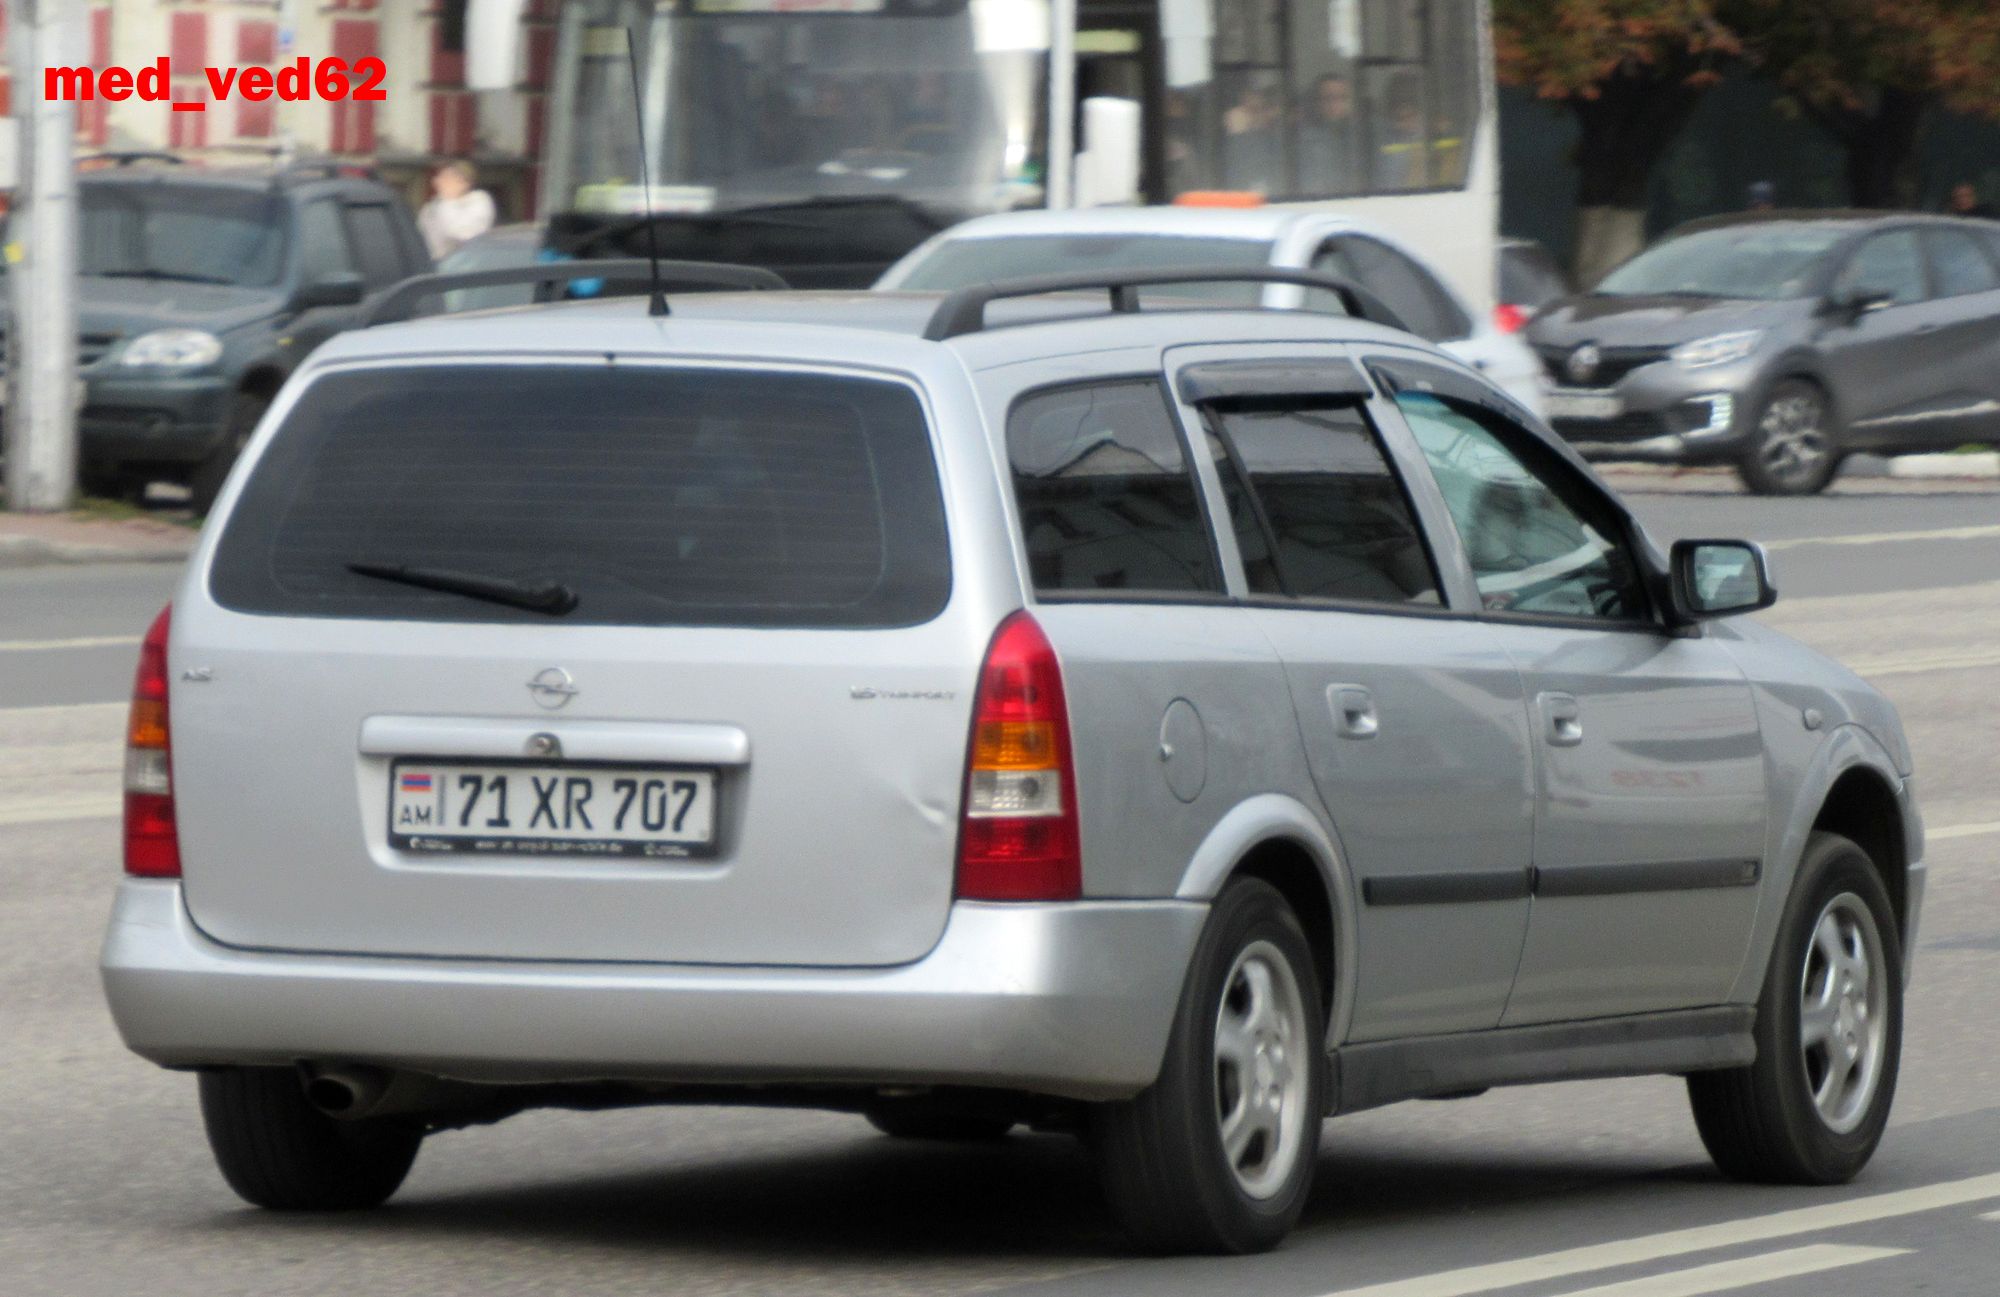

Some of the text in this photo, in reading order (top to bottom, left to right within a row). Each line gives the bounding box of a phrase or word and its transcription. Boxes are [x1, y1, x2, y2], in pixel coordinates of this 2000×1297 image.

[401, 804, 431, 825] AM
[458, 774, 699, 833] 71 XR 707
